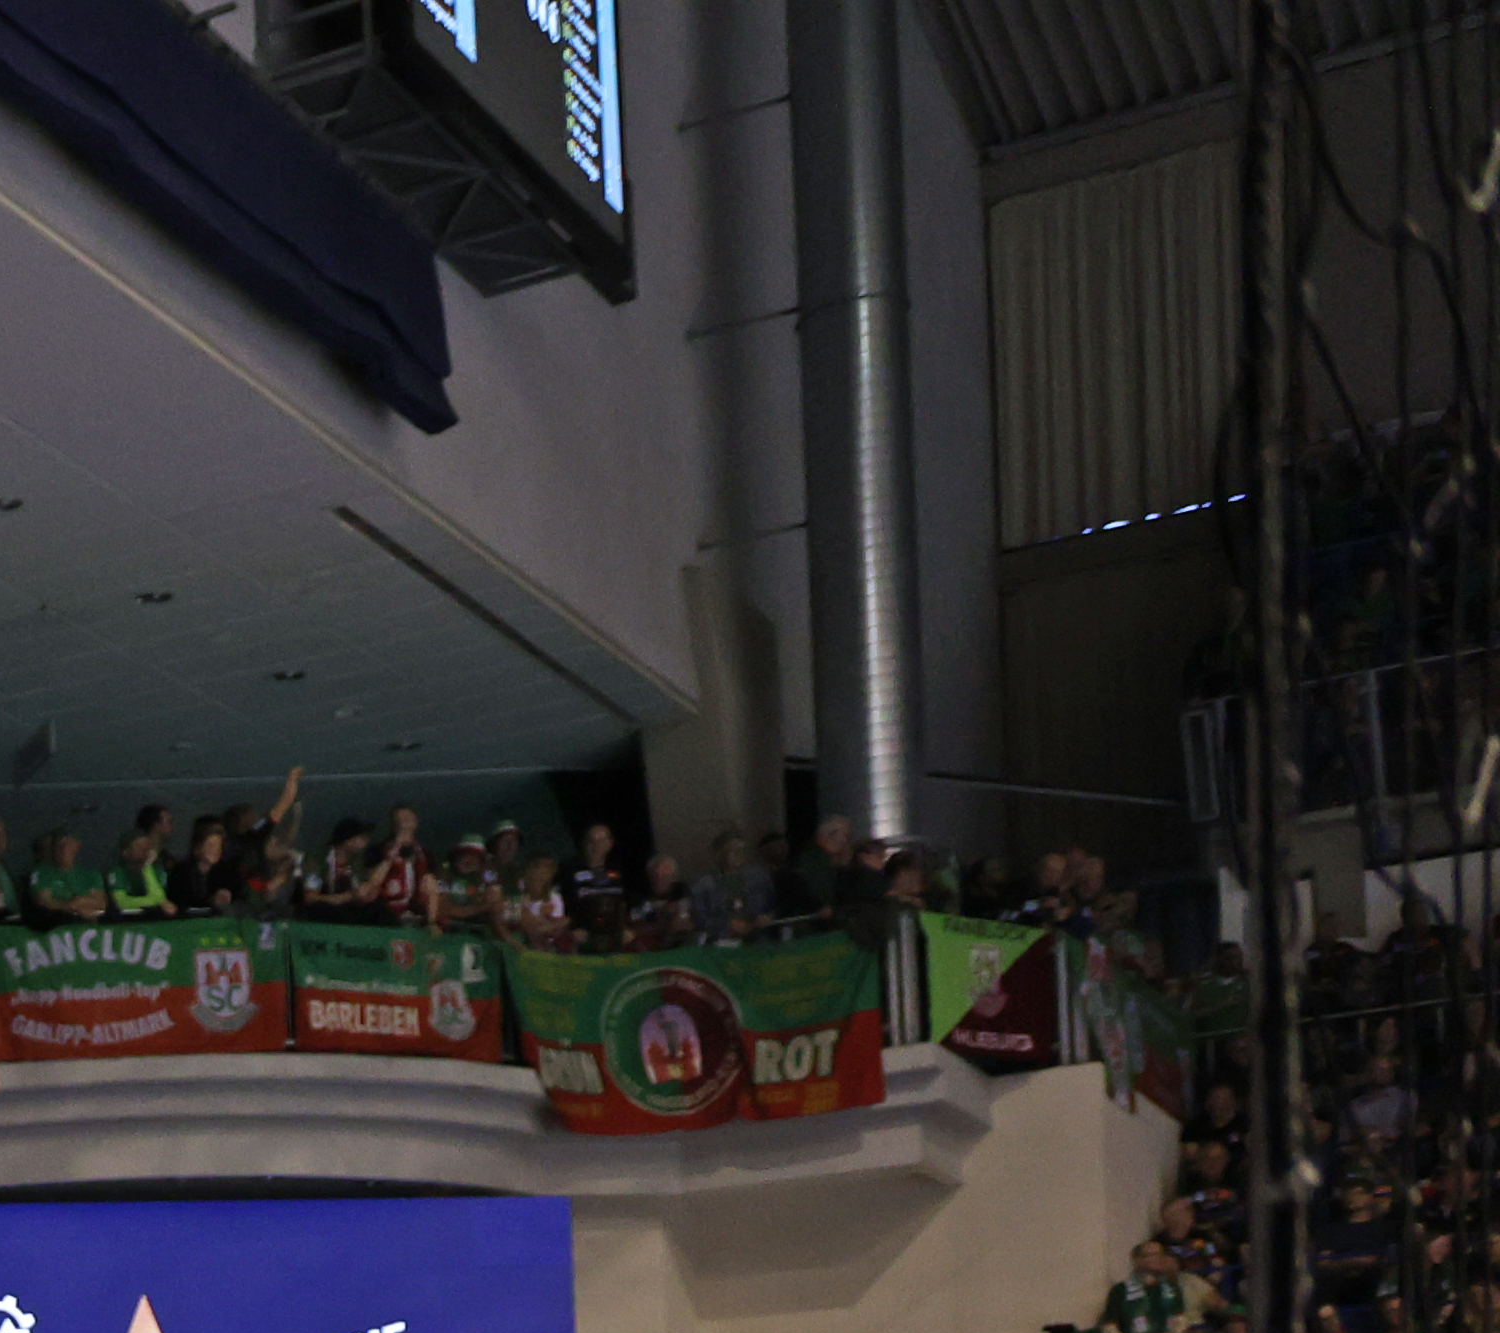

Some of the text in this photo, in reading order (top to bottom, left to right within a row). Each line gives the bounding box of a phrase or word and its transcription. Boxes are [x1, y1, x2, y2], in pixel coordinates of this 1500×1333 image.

[4, 929, 172, 977] FANCLUB
[309, 999, 420, 1036] BARLEBEN
[756, 1029, 840, 1084] ROT
